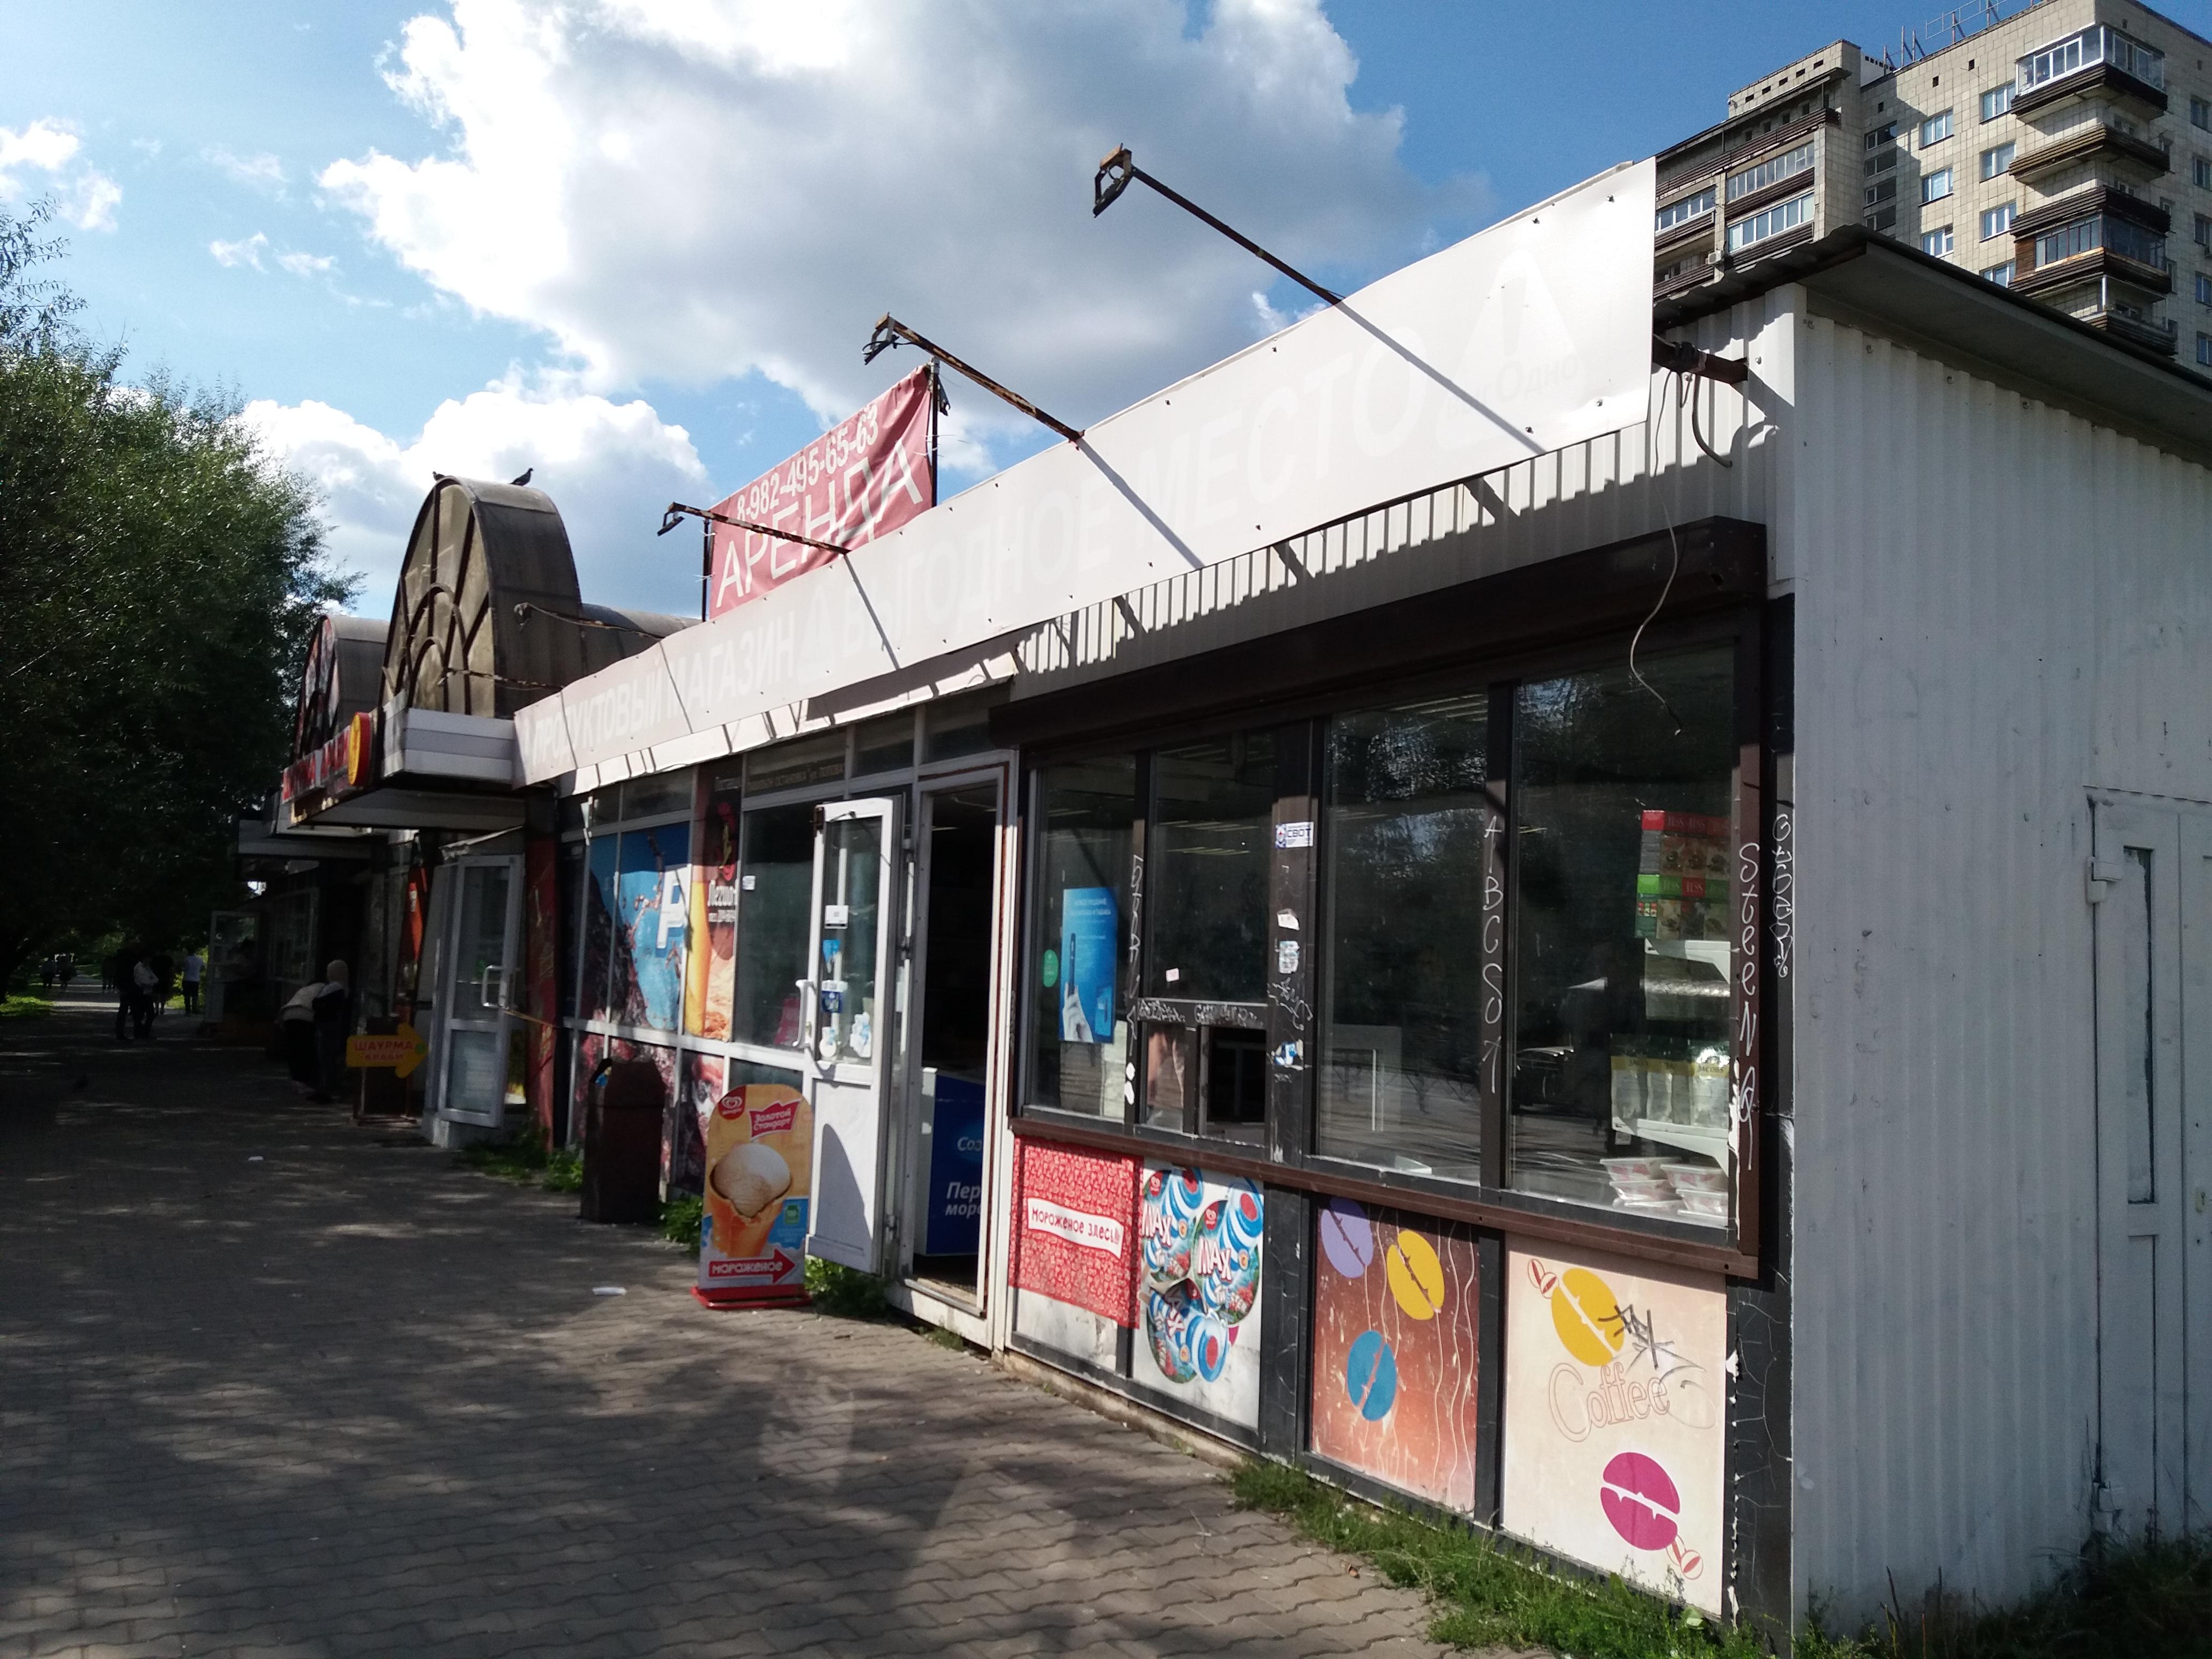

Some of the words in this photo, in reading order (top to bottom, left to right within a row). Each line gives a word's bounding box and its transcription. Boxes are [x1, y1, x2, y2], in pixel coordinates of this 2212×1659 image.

[737, 404, 879, 521] 8-982-495-65-63
[668, 610, 795, 719] МАГАЗИН
[1135, 326, 1427, 552] МЕСТО
[716, 438, 923, 608] АРЕНДА
[1686, 883, 1703, 893] TESS
[355, 1040, 413, 1051] ШАУРМА
[1141, 1201, 1172, 1248] MAX
[1198, 1236, 1232, 1281] MAX
[1548, 1361, 1670, 1443] Coffee
